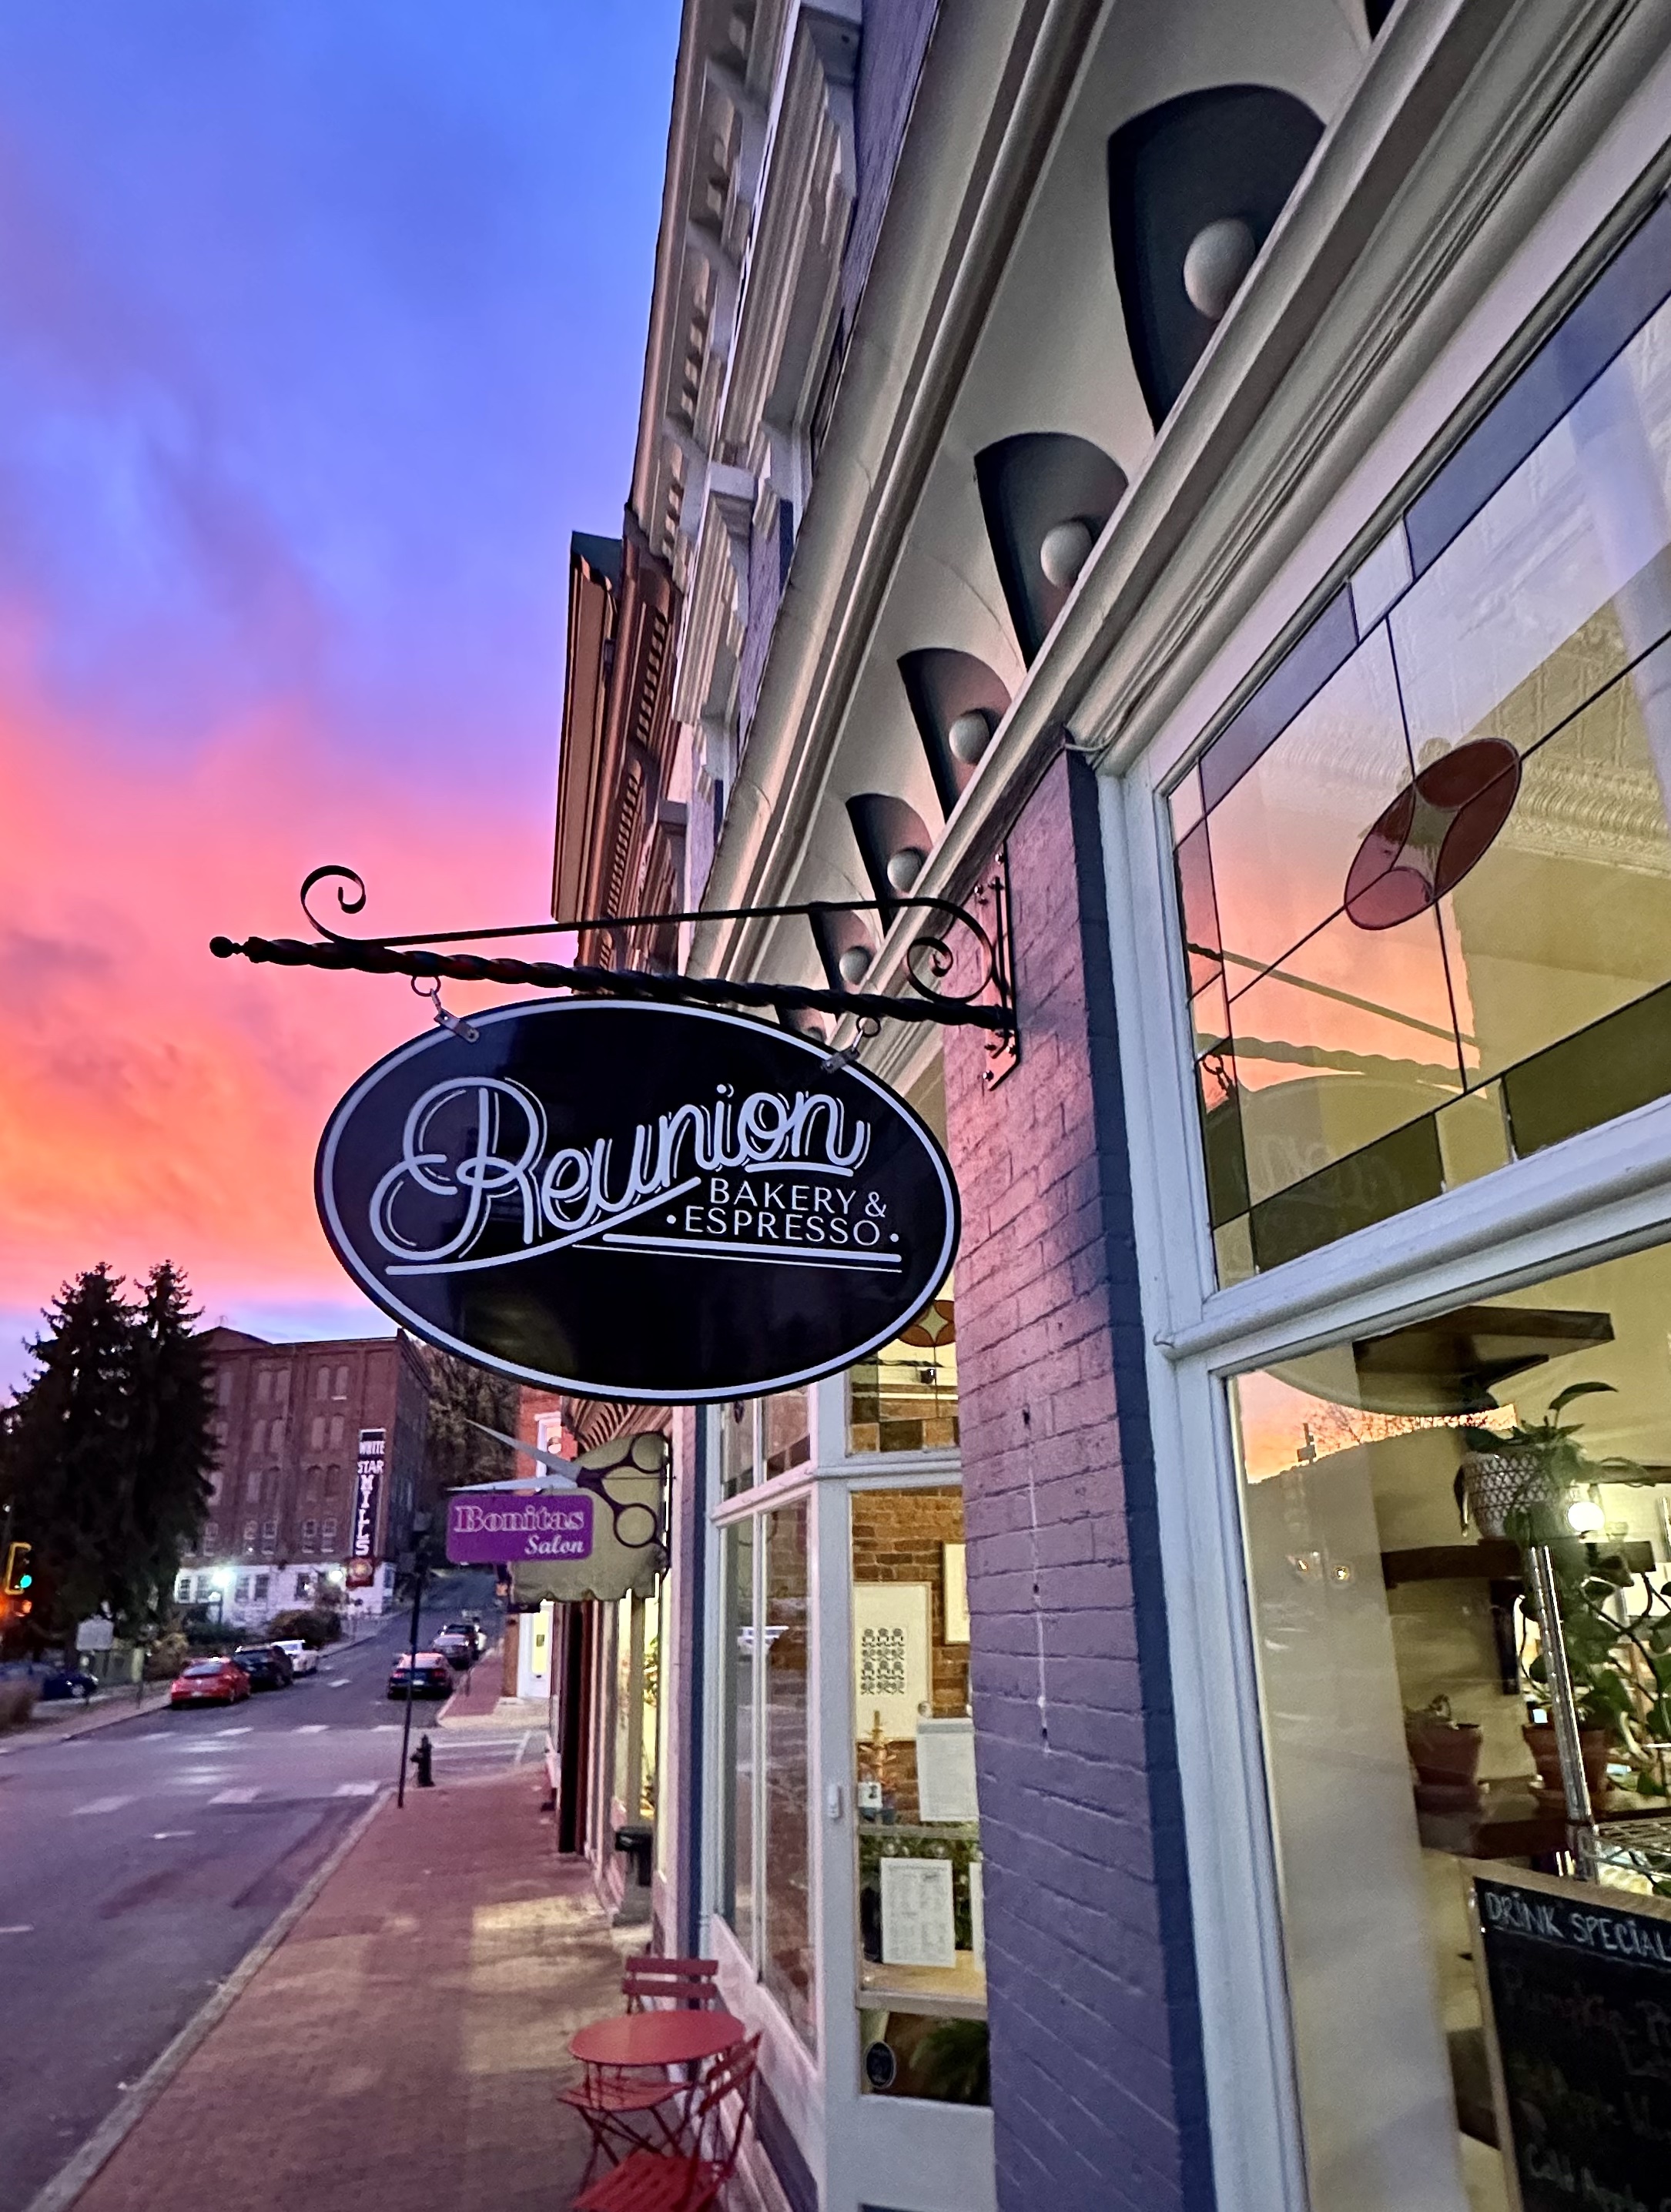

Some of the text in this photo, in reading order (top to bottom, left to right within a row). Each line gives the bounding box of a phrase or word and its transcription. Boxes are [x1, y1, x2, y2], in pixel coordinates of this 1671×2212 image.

[369, 1076, 871, 1261] Reunion
[710, 1177, 886, 1217] BAKERY &
[685, 1205, 880, 1246] ESPRESSO
[359, 1441, 385, 1454] WHITE
[357, 1460, 384, 1474] STAR
[355, 1474, 374, 1556] MILLS
[454, 1505, 584, 1532] Bonitas
[524, 1534, 584, 1554] Salon
